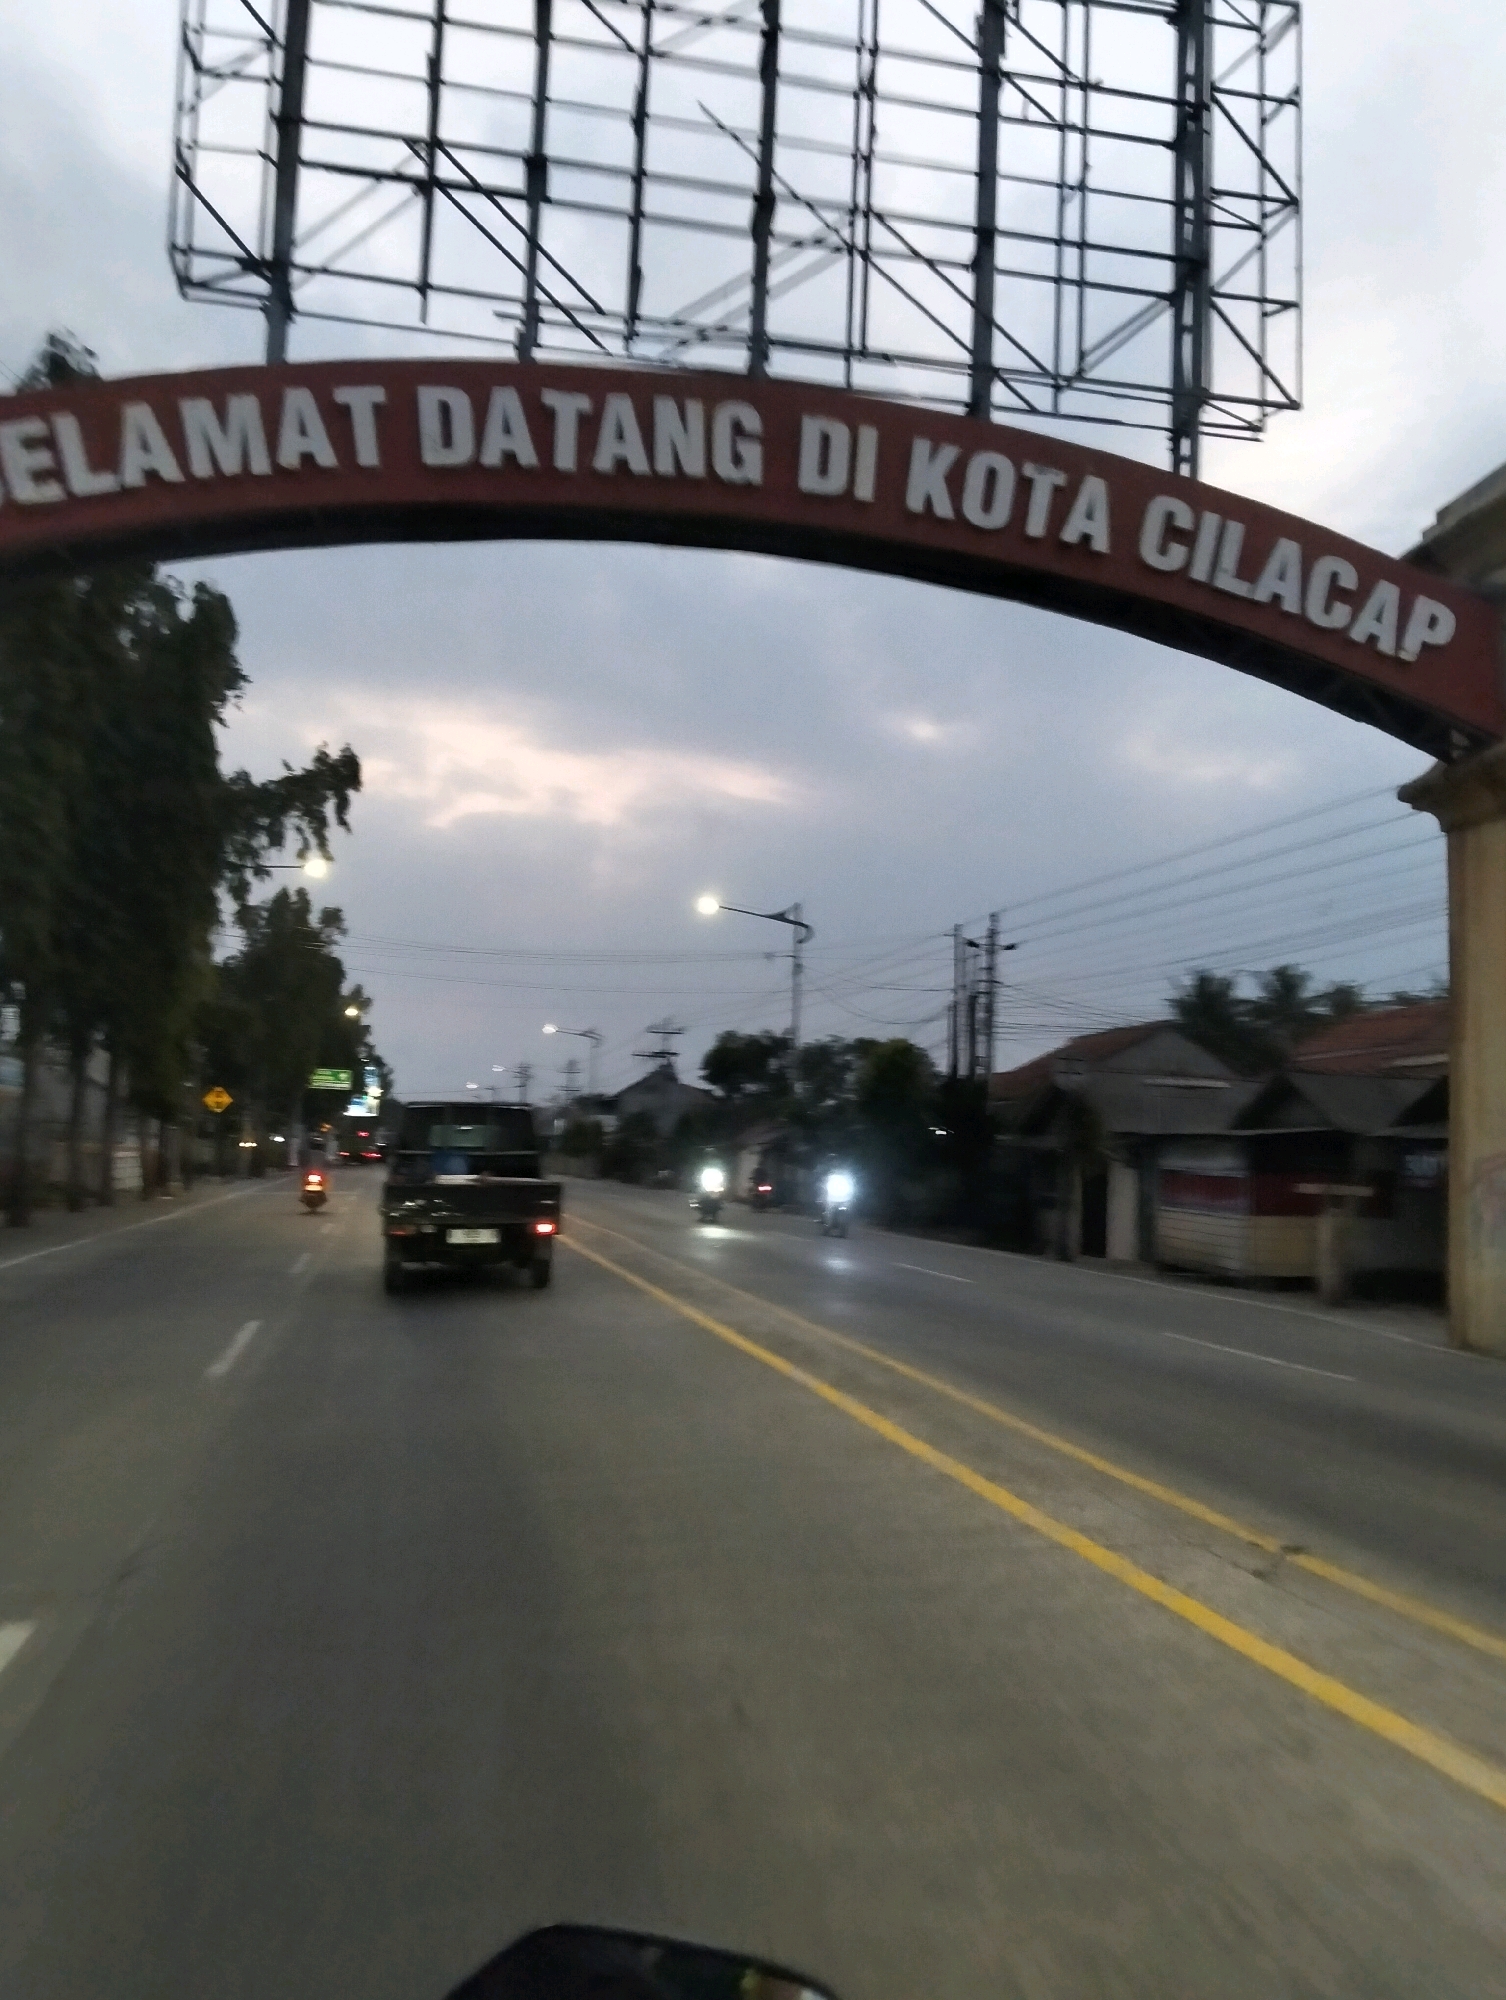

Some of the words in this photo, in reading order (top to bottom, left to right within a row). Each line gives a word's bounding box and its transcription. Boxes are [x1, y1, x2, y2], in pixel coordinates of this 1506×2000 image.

[0, 385, 386, 505] ELAMAT
[417, 386, 763, 485] DATANG
[799, 415, 880, 502] DI
[904, 437, 1111, 554] KOTA
[1138, 495, 1457, 663] CILACAP
